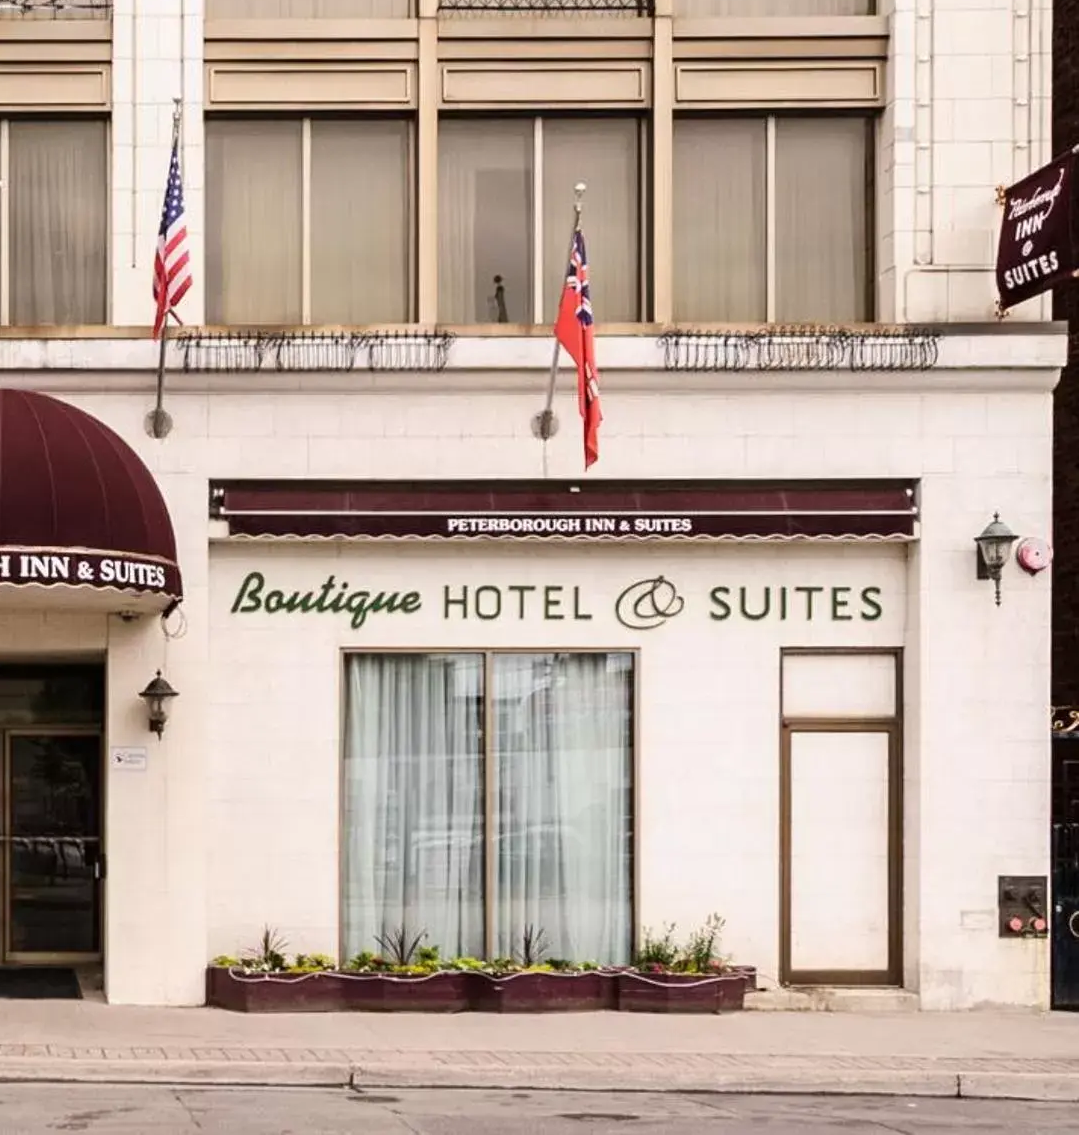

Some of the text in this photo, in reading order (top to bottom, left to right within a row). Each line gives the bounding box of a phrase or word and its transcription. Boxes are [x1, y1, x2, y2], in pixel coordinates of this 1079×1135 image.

[1015, 211, 1044, 241] INN
[1004, 250, 1059, 289] SUITES
[447, 518, 692, 532] PETERBOROUGH INN & SUITES
[19, 555, 70, 578] INN
[77, 561, 94, 580] &
[100, 559, 166, 588] SUITES
[230, 571, 422, 630] Boutique
[443, 585, 593, 620] HOTEL
[709, 586, 883, 621] SUITES
